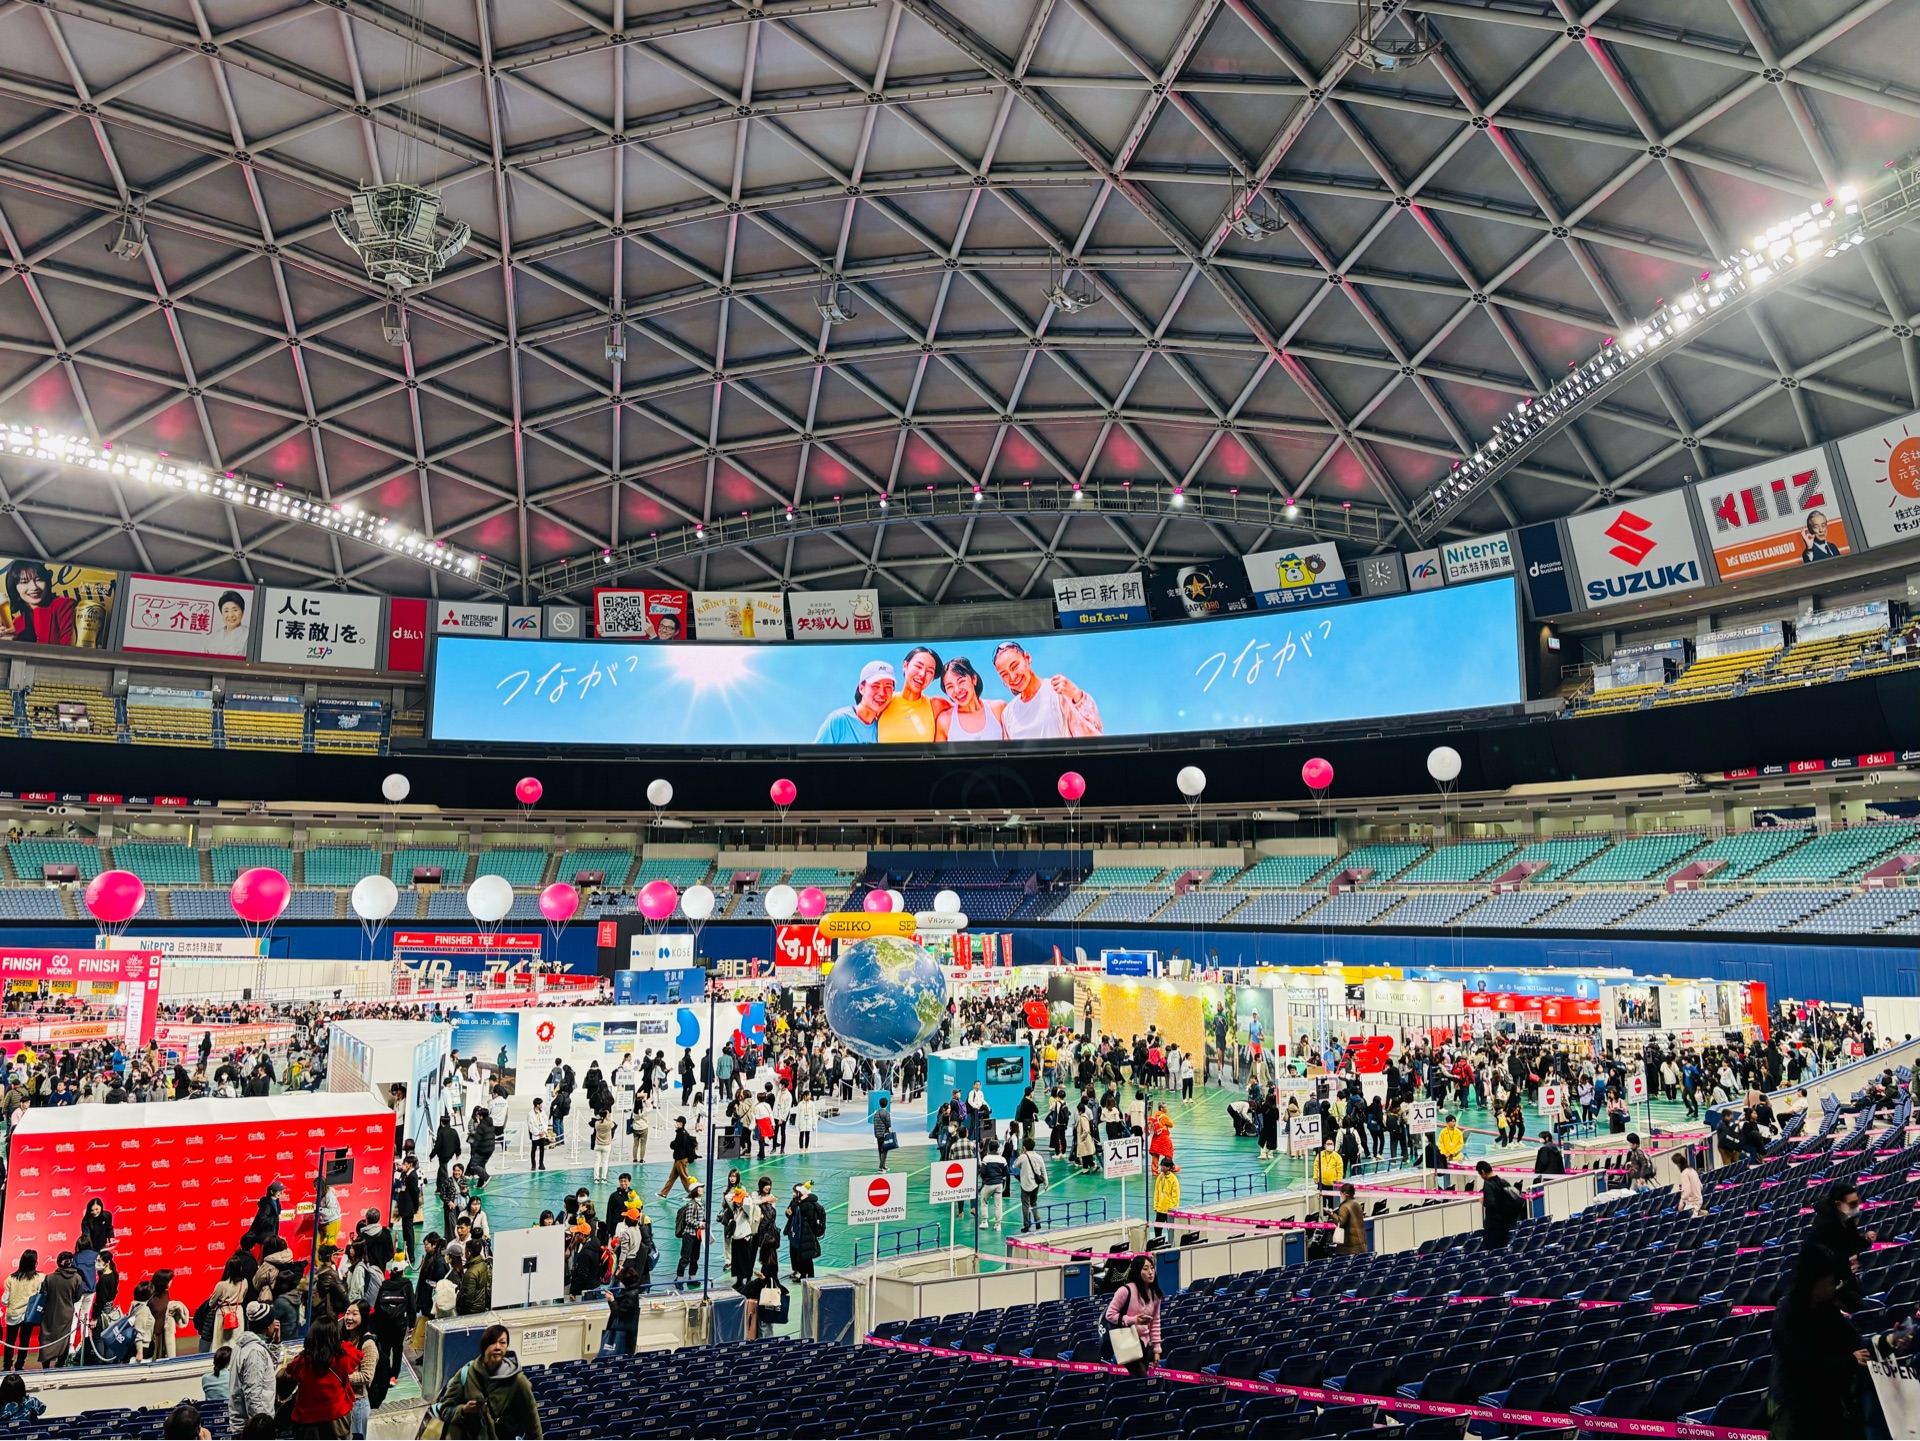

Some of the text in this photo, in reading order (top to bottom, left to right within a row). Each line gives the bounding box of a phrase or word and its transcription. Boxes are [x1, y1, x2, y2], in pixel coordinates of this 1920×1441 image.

[1447, 540, 1509, 564] Niterra
[1739, 542, 1795, 564] HEISEI KANKOU
[1450, 556, 1511, 578] 日本特殊陶業
[1540, 565, 1563, 575] business
[1587, 560, 1699, 601] SUZUKI
[648, 594, 683, 604] CBC
[1058, 582, 1142, 605] 中日新聞
[1264, 584, 1338, 605] 東海テレビ
[278, 596, 321, 617] 人に
[696, 599, 727, 616] KIRIN'S
[757, 601, 781, 614] BREW
[807, 608, 836, 616] みそかつ
[1186, 600, 1220, 613] SAPPORO
[169, 612, 210, 632] 介護
[462, 614, 499, 622] MITSUBISHI
[462, 620, 493, 628] ELECTRIC
[755, 619, 783, 627] 一番搾り
[797, 616, 850, 631] 矢場とん
[1080, 613, 1129, 624] 中日スポーツ
[275, 619, 366, 644] 「素敵」を。
[392, 627, 423, 639] d払い
[829, 920, 872, 932] SEIKO
[140, 940, 175, 952] Niterra
[434, 936, 495, 945] FINISHER TEE
[776, 927, 812, 965] くすり
[672, 946, 691, 958] KOSÉ
[2, 958, 42, 971] FINISH
[52, 954, 69, 967] GO
[78, 958, 120, 973] FINISH
[46, 967, 73, 976] WOMEN
[1390, 992, 1405, 1004] your
[492, 1018, 511, 1026] Earth.
[1414, 1108, 1435, 1120] 入口
[1295, 1122, 1319, 1136] 入口
[1108, 1138, 1140, 1147] マラソンEXPO
[1109, 1145, 1139, 1162] 入口
[1370, 1398, 1387, 1406] WOMEN
[1402, 1402, 1421, 1410] WOMEN
[1437, 1406, 1456, 1414] WOMEN
[1474, 1410, 1493, 1418] WOMEN
[1512, 1413, 1533, 1422] WOMEN
[1552, 1417, 1574, 1426] WOMEN
[1595, 1420, 1619, 1429] WOMEN
[1640, 1424, 1665, 1433] WOMEN
[1688, 1428, 1715, 1438] WOMEN
[1740, 1433, 1767, 1441] WOMEN
